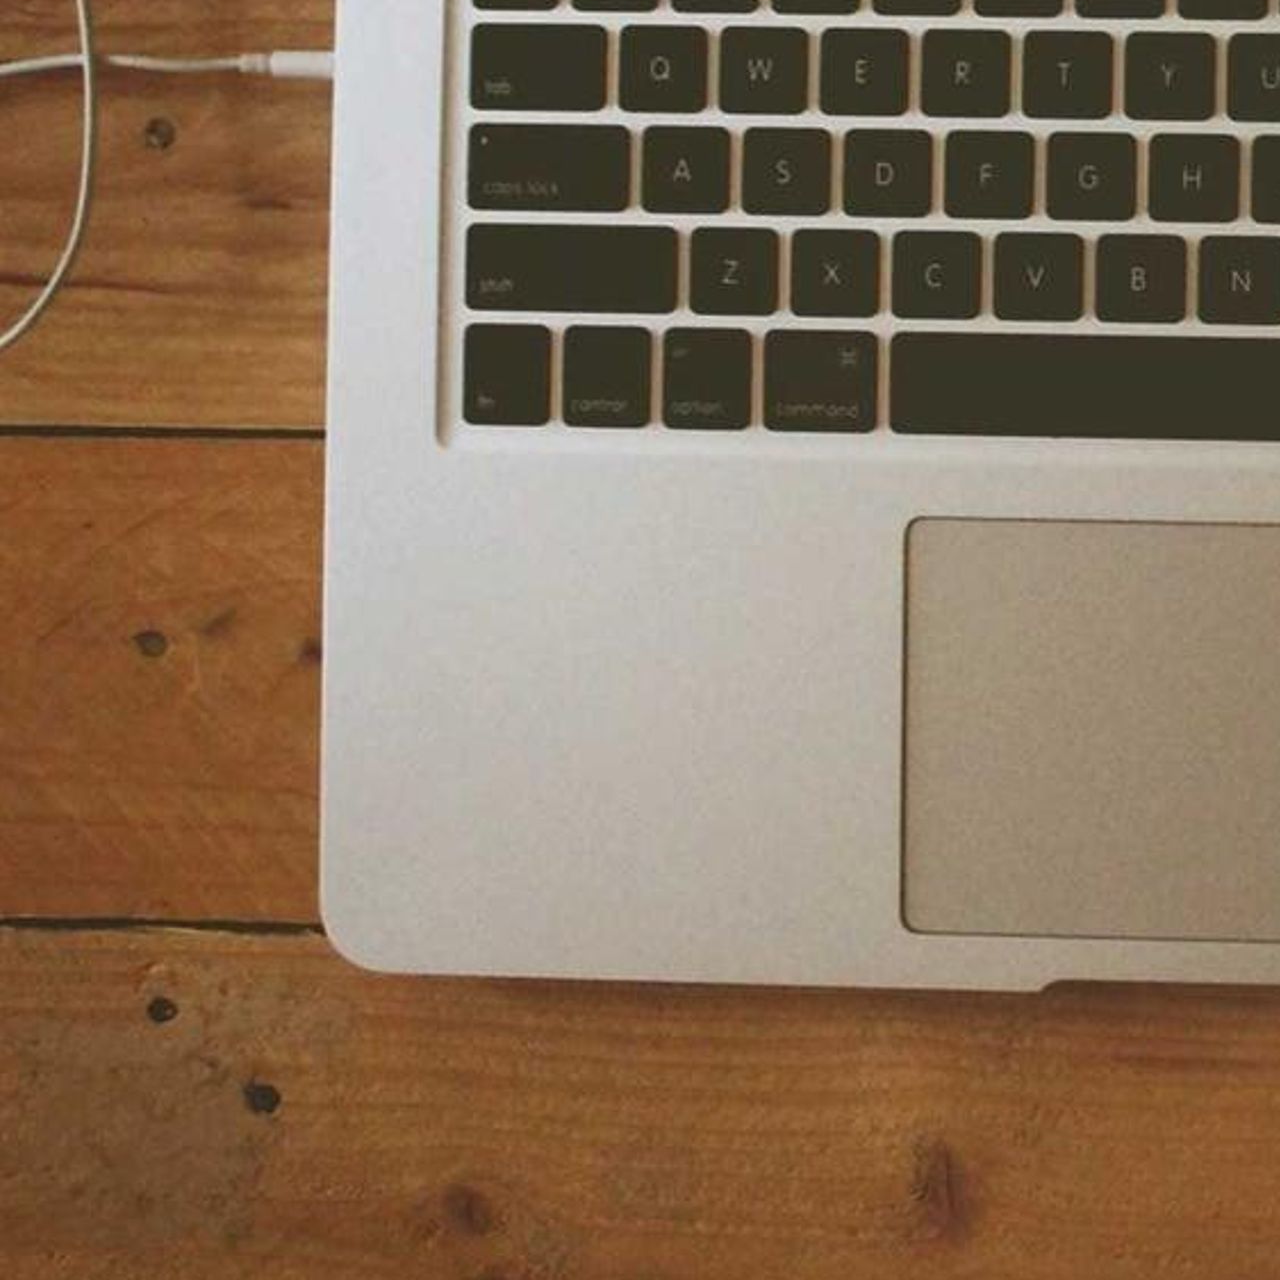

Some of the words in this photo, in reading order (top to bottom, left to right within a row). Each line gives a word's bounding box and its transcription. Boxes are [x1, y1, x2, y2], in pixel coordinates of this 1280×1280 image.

[650, 55, 671, 81] Q
[747, 58, 773, 81] W
[854, 58, 868, 85] E
[955, 60, 971, 84] R
[1057, 61, 1071, 86] T
[1160, 63, 1174, 87] Y
[672, 158, 692, 182] A
[775, 159, 792, 185] S
[875, 161, 895, 186] D
[979, 162, 993, 184] F
[1078, 164, 1099, 190] G
[1182, 166, 1202, 190] H
[721, 259, 739, 285] Z
[824, 264, 841, 284] X
[924, 262, 942, 289] C
[1027, 266, 1045, 288] V
[1130, 266, 1147, 292] B
[1231, 270, 1252, 292] N
